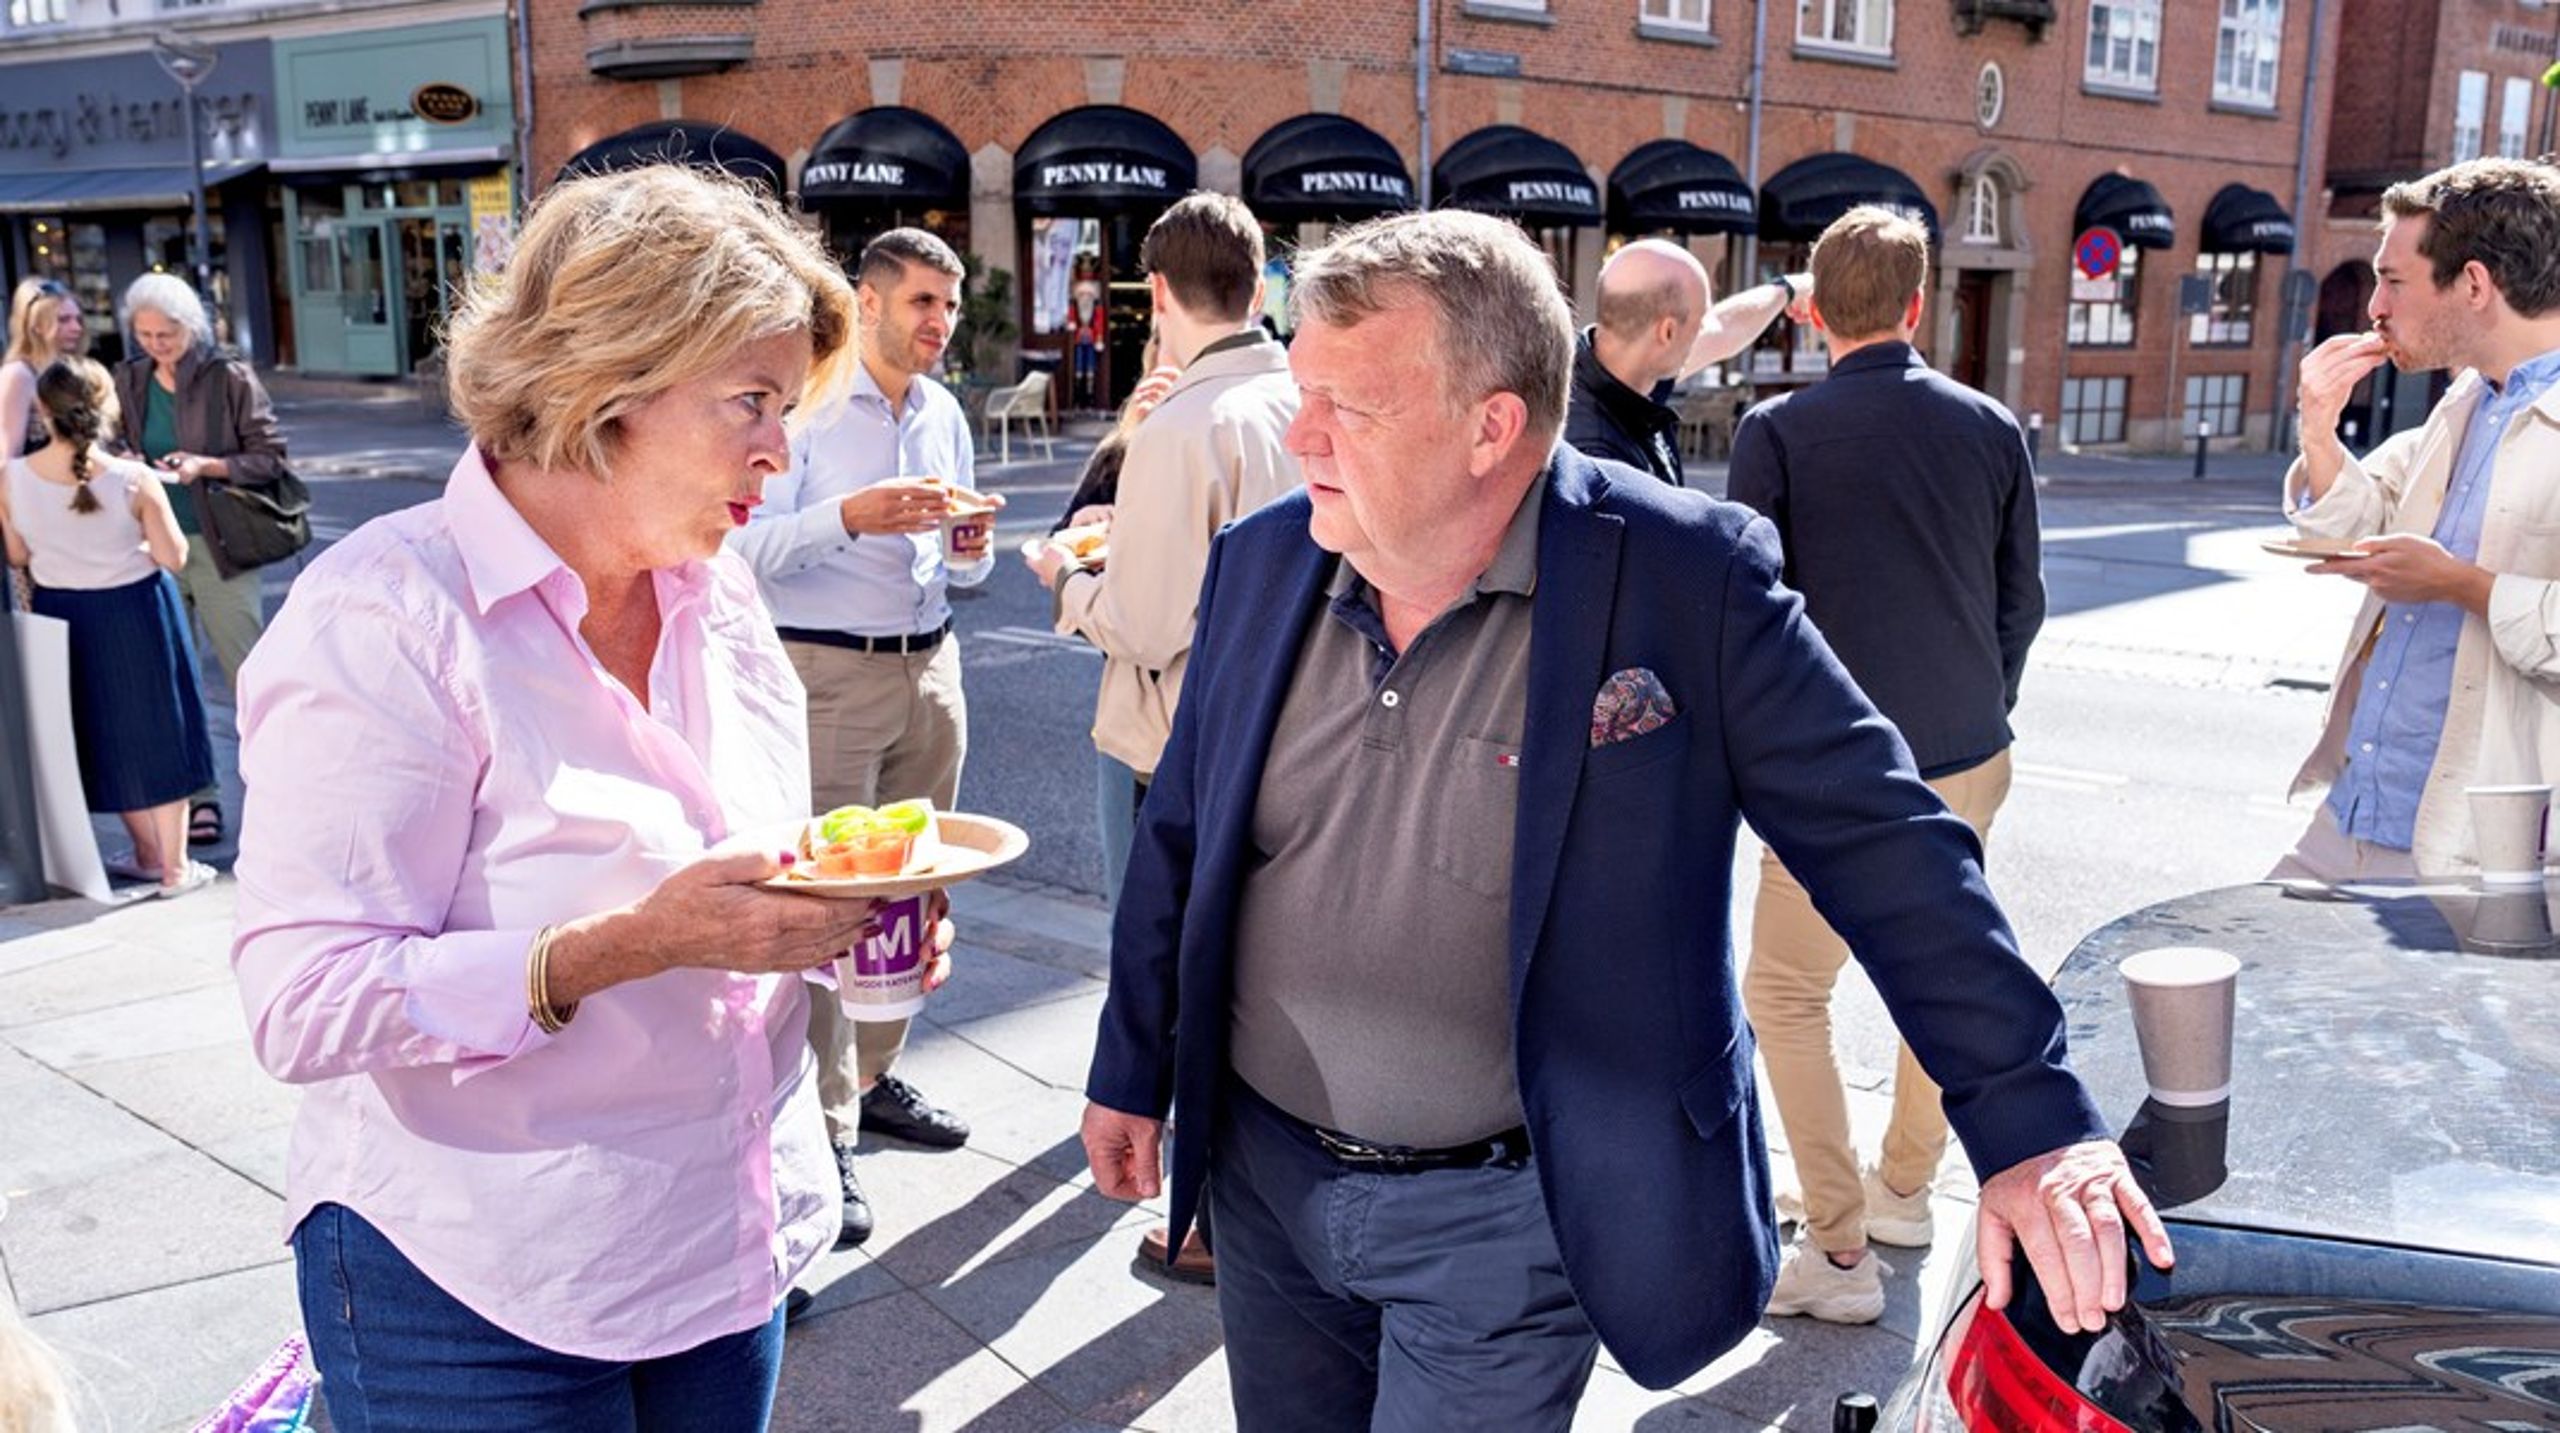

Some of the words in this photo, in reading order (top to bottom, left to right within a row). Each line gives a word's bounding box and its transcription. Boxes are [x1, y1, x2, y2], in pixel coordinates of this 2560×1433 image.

[853, 163, 904, 185] LANE
[1043, 162, 1112, 187] PENNY
[1114, 164, 1166, 188] LANE
[1302, 171, 1368, 192] PENNY
[1509, 181, 1562, 201] PENNY
